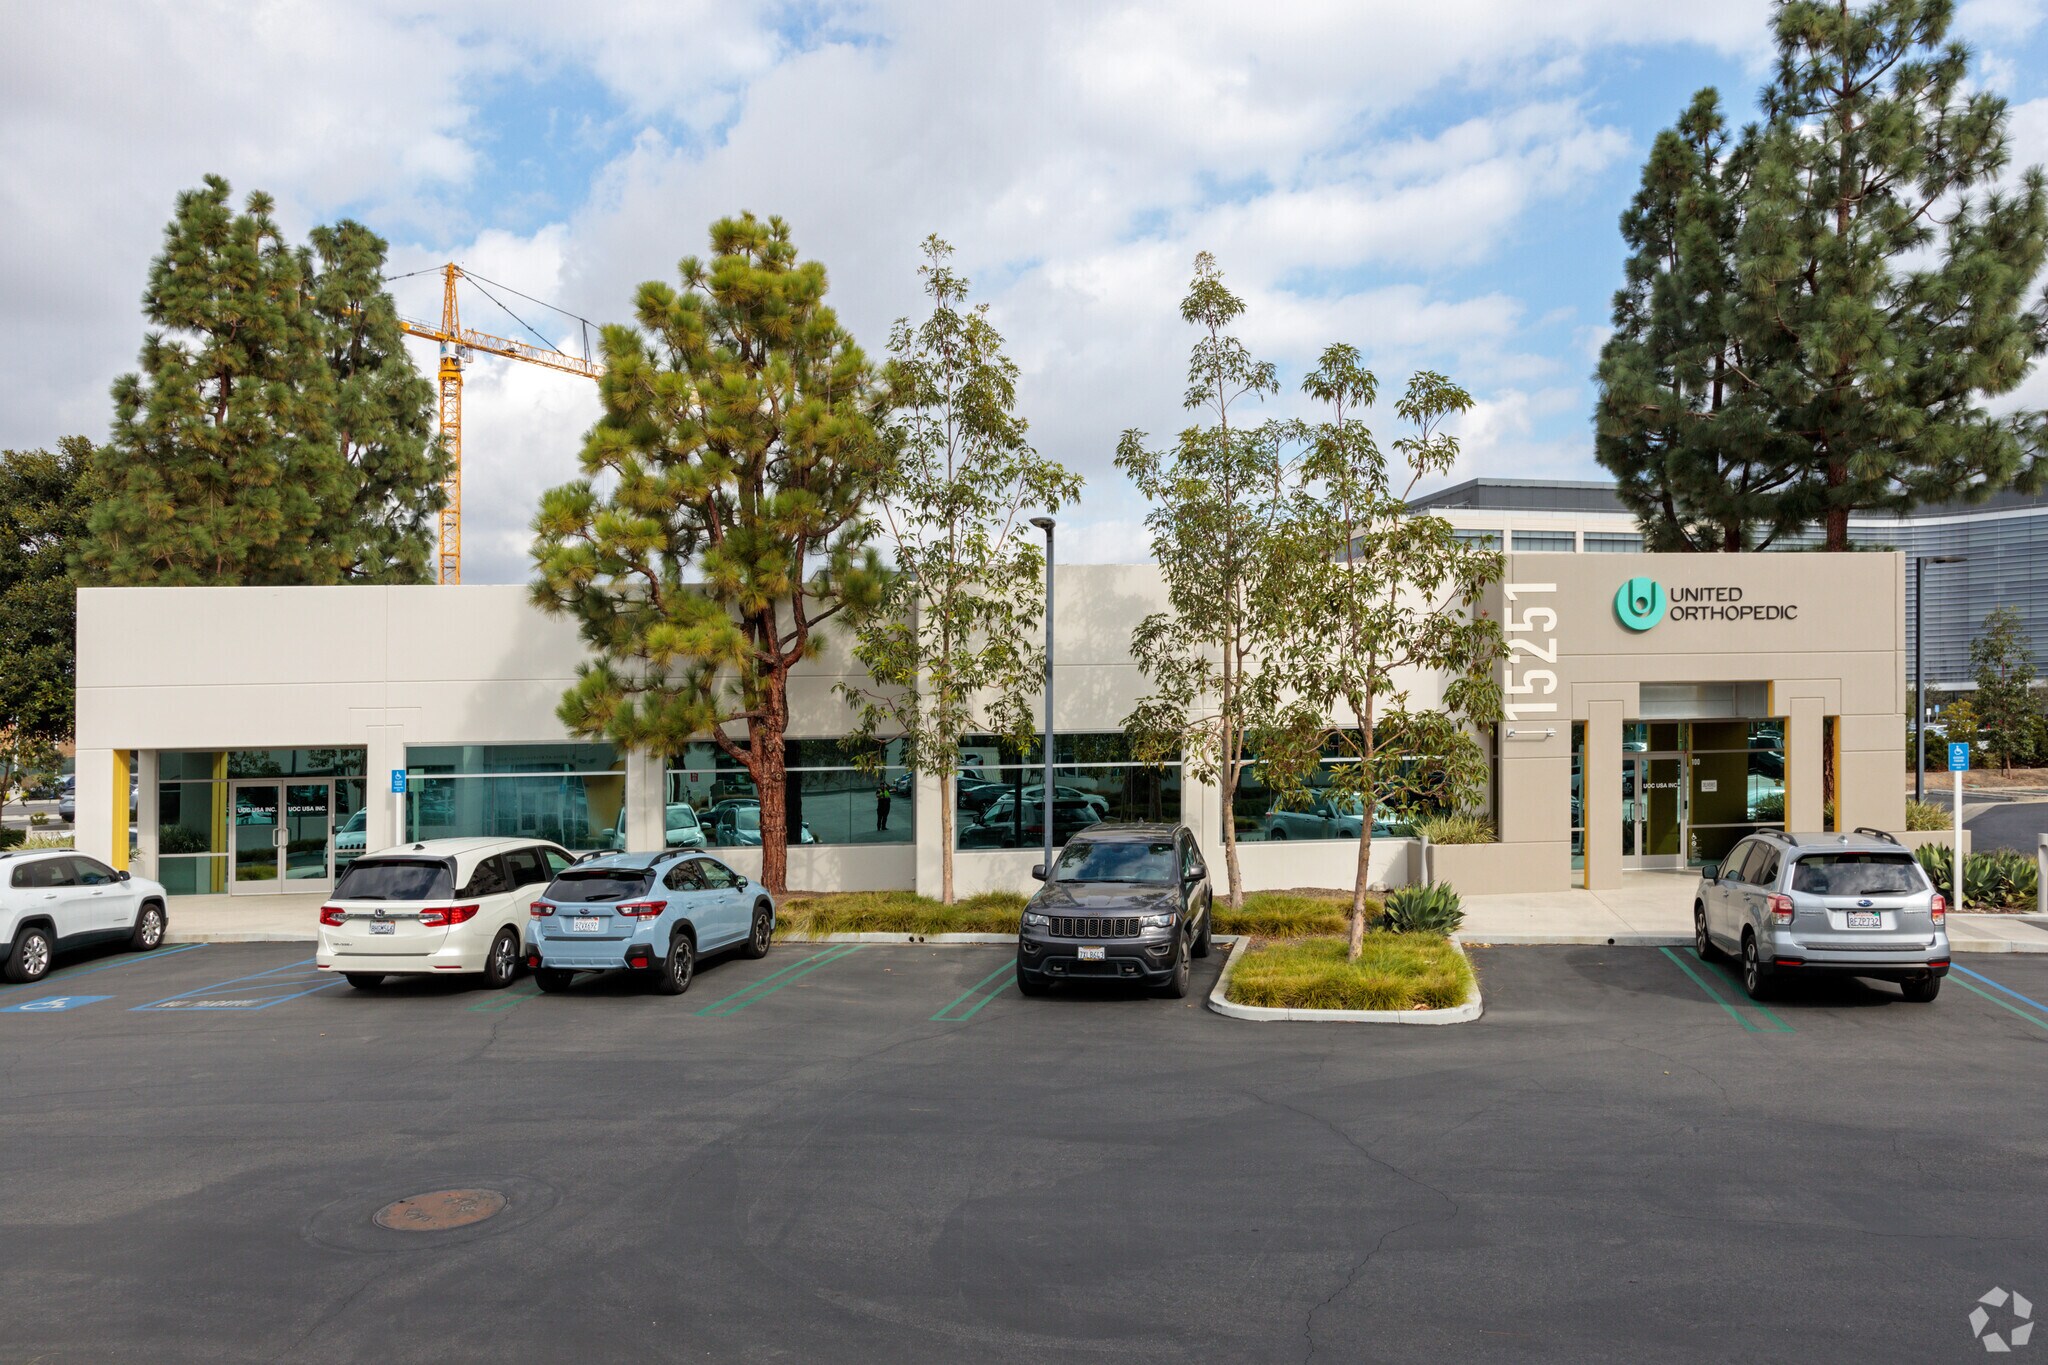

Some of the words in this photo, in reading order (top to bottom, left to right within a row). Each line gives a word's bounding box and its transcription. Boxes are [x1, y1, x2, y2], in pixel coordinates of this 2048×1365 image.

[1670, 587, 1743, 602] UNITED
[1670, 605, 1798, 621] ORTHOPEDIC
[1504, 583, 1558, 720] 15251
